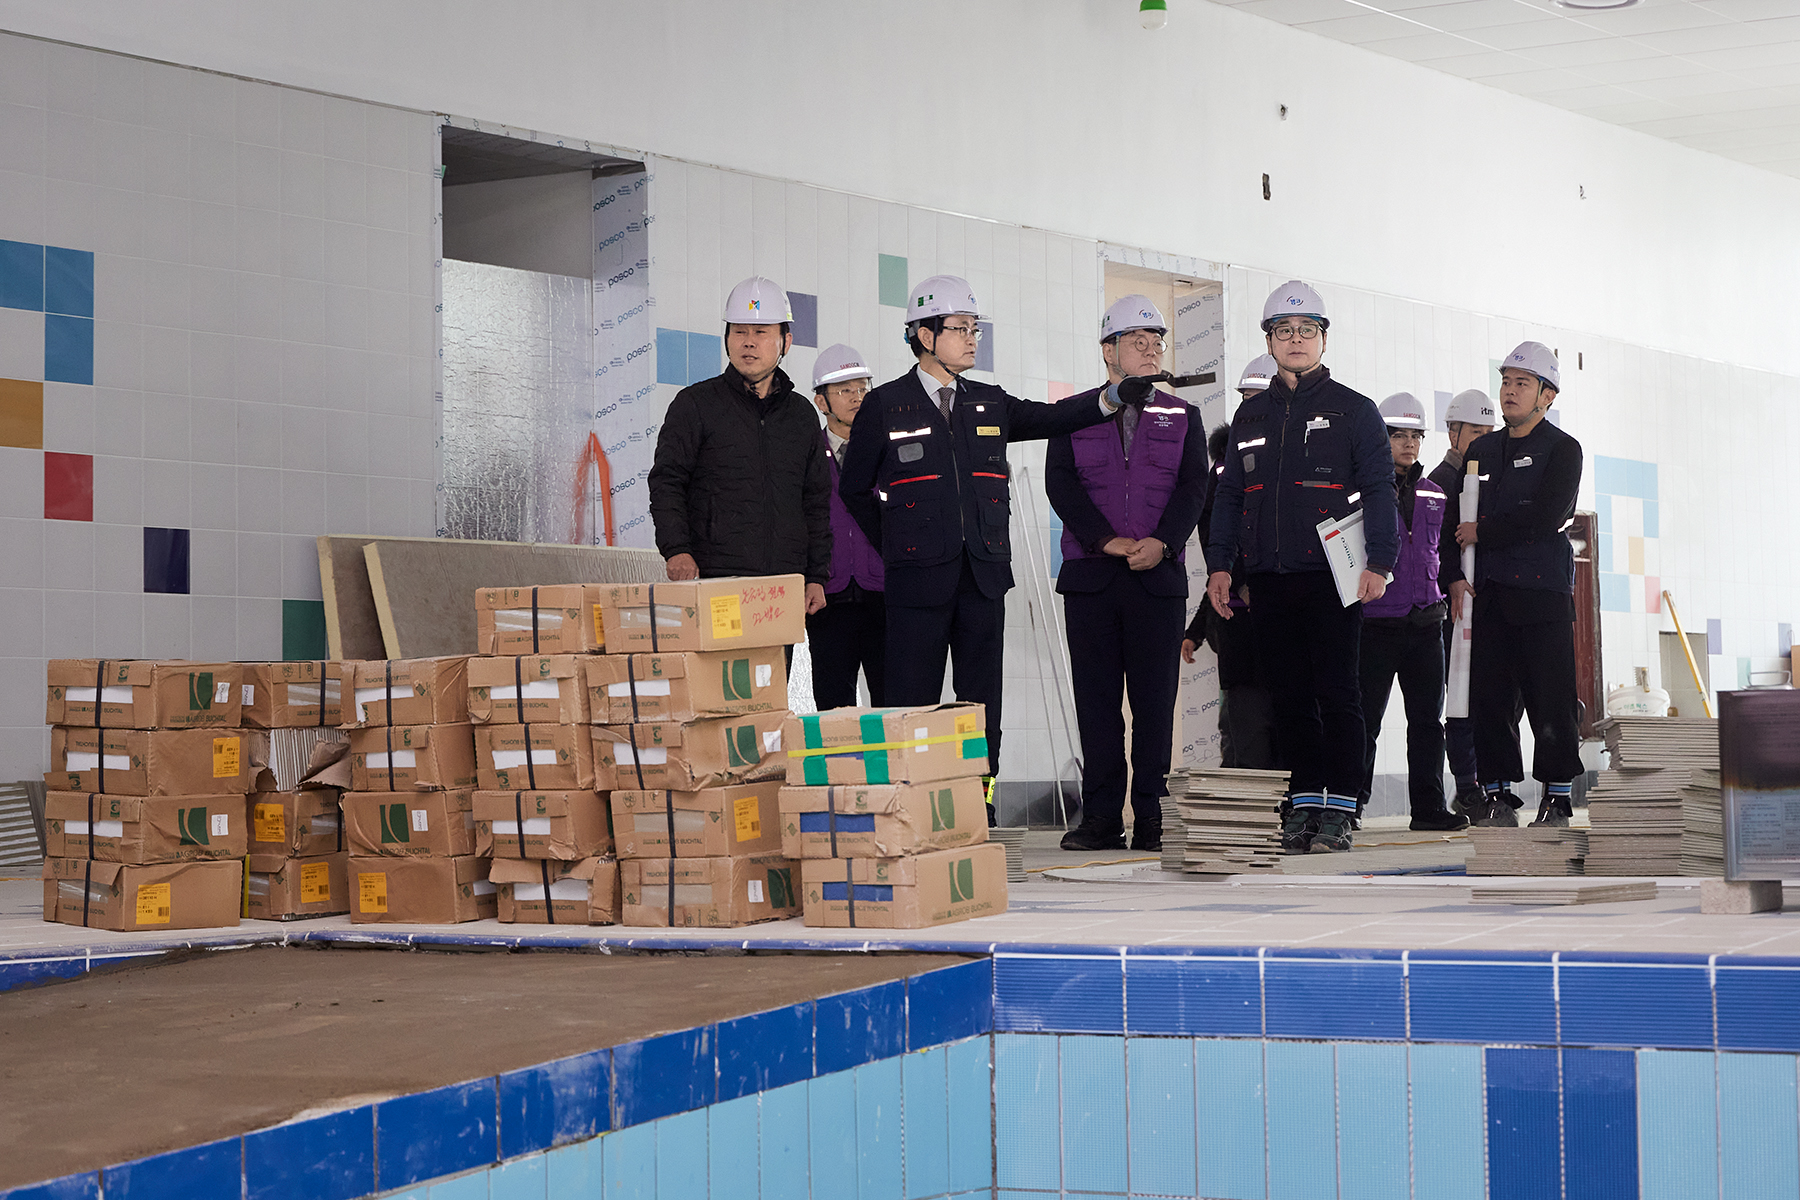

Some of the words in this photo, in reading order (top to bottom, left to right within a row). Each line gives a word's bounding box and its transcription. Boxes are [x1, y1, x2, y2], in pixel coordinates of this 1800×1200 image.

[599, 231, 625, 252] posco
[608, 267, 634, 289] posco
[617, 304, 644, 326] posco
[1178, 300, 1201, 317] posco
[1186, 329, 1210, 346] posco
[626, 342, 653, 363] posco
[1195, 359, 1219, 376] posco
[610, 477, 636, 498] posco
[619, 515, 646, 535] posco
[1193, 666, 1217, 682] posco
